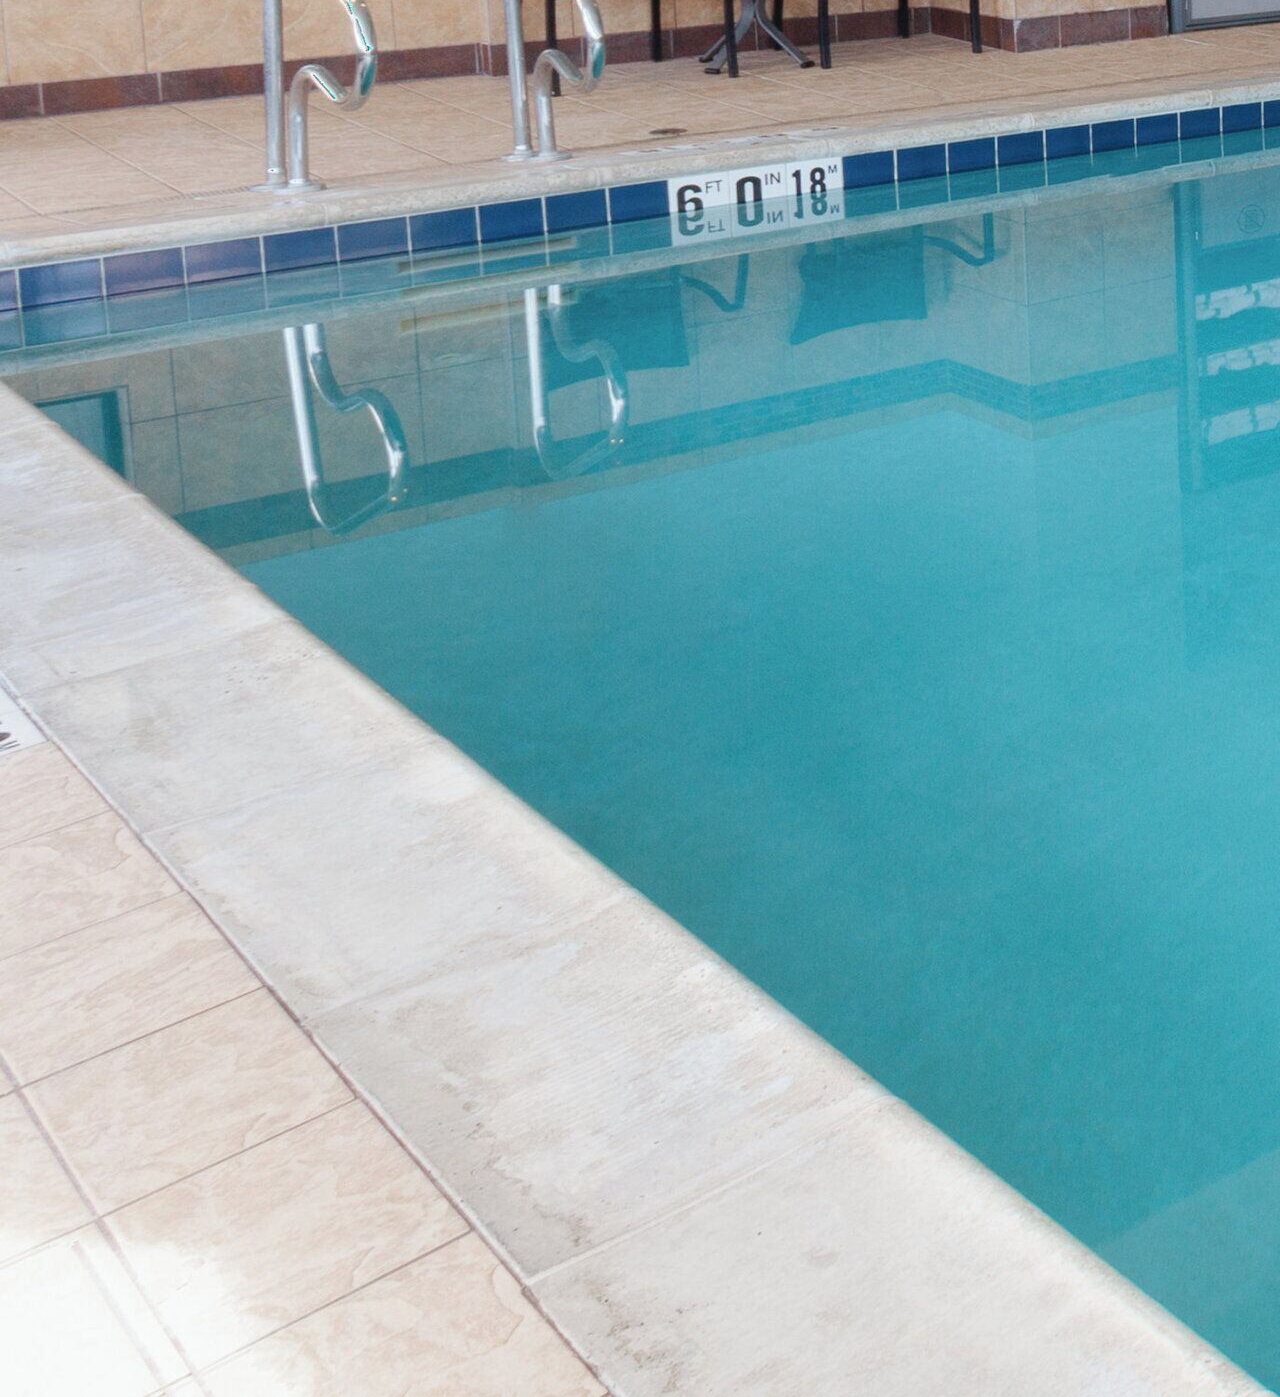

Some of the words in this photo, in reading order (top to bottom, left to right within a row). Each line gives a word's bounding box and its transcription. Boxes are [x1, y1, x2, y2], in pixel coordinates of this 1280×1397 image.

[705, 180, 722, 194] FT
[736, 176, 764, 222] 0
[764, 172, 781, 185] IN
[828, 165, 838, 173] M
